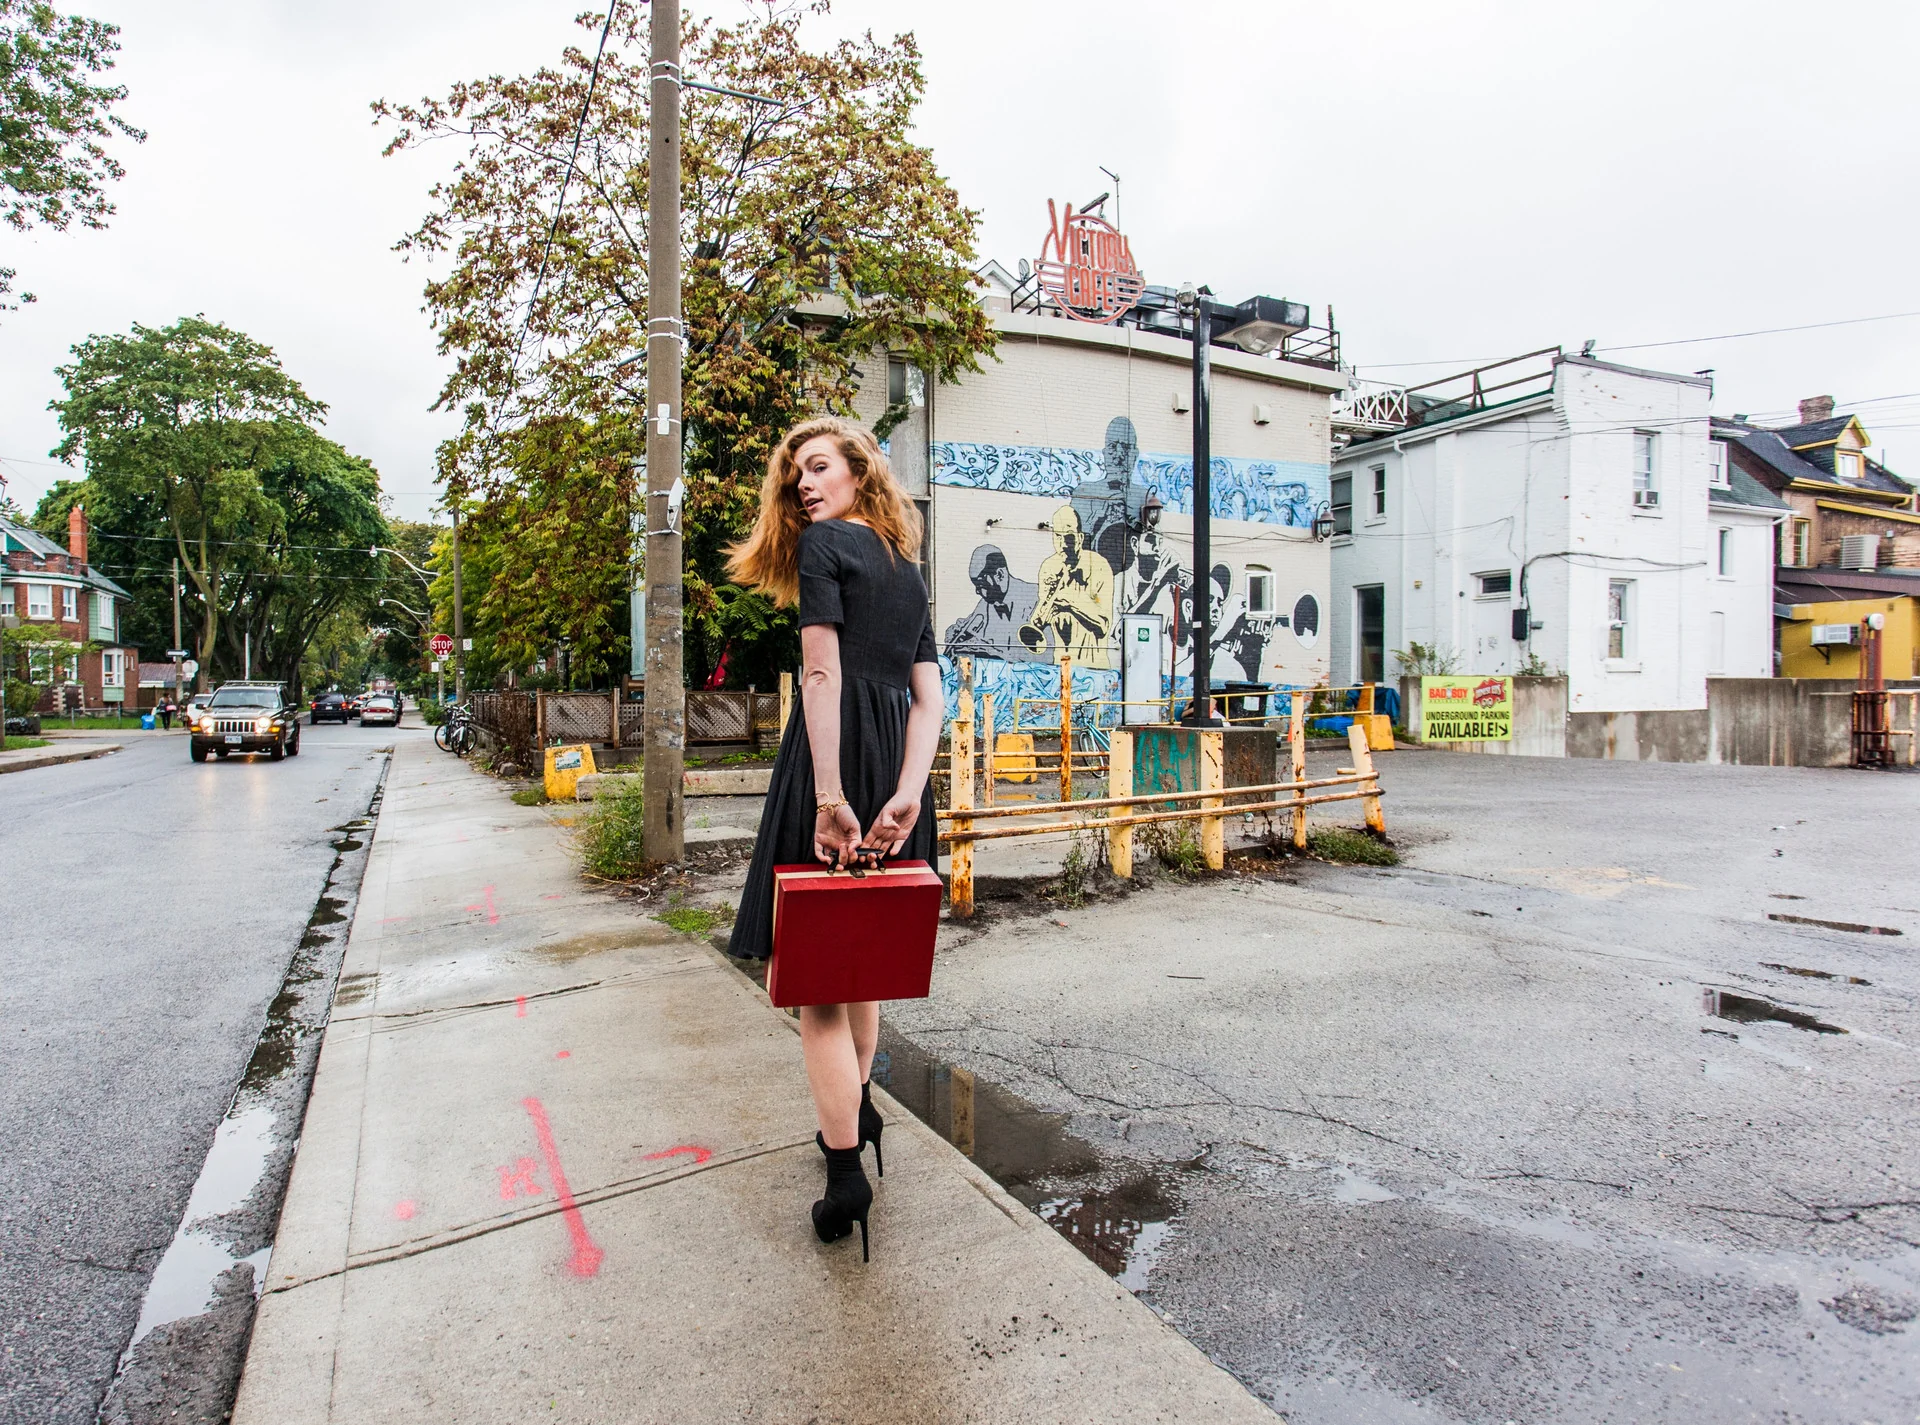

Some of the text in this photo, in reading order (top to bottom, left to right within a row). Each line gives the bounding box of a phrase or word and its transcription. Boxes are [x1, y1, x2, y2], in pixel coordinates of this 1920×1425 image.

[1048, 198, 1129, 273] VICTORY
[1068, 265, 1113, 311] CAFE
[432, 640, 452, 650] STOP
[1429, 688, 1446, 698] BAD
[1451, 688, 1468, 698] BOY
[1425, 711, 1510, 720] UNDERGROUND PARKING
[1428, 722, 1498, 738] AVAILABLE!
